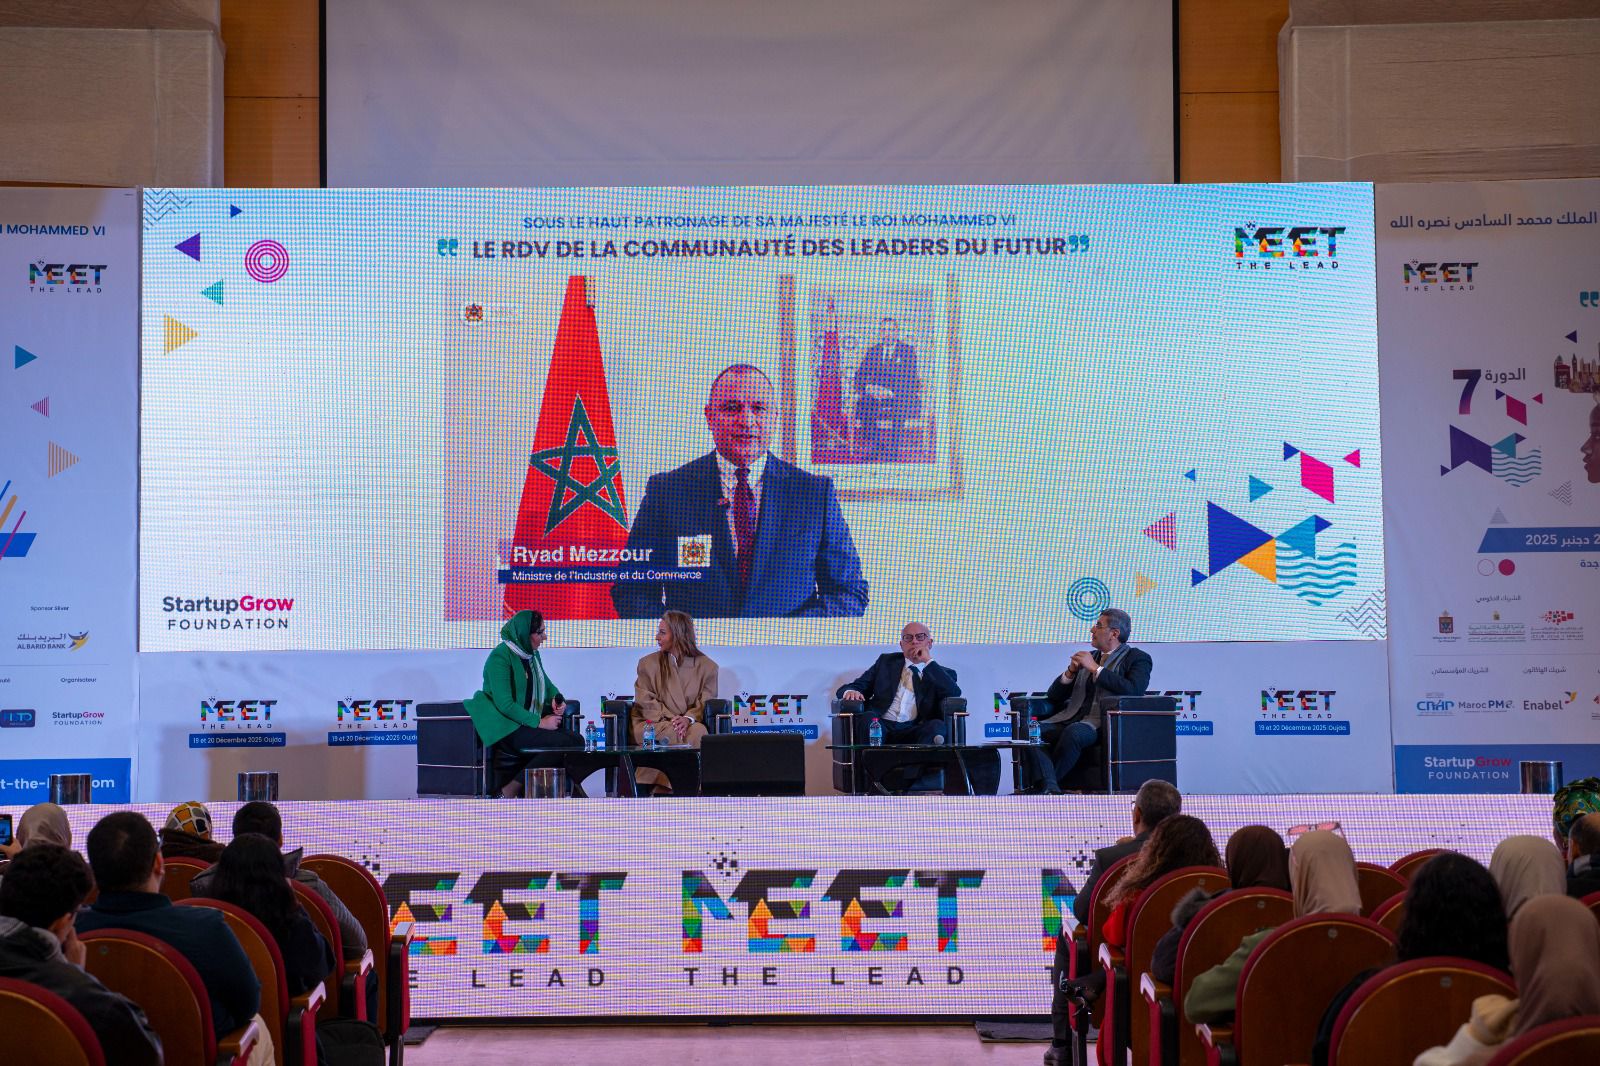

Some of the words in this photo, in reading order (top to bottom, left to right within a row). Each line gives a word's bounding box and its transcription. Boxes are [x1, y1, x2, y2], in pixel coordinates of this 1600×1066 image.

[524, 216, 565, 229] SOUS
[569, 216, 584, 228] LE
[589, 216, 628, 228] HAUT
[635, 216, 728, 228] PATRONAGE
[733, 215, 750, 227] DE
[756, 215, 776, 227] SA
[781, 212, 848, 227] MAJESTÉ
[853, 214, 867, 227] LE
[872, 214, 897, 227] ROI
[902, 214, 996, 227] MOHAMMED
[1002, 214, 1015, 226] VI
[1390, 216, 1413, 228] الله
[1417, 216, 1450, 230] نصره
[1455, 214, 1511, 231] السادس
[1516, 215, 1553, 227] محمد
[1556, 211, 1597, 226] الملك
[7, 224, 88, 236] MOHAMMED
[93, 225, 105, 236] VI
[473, 241, 496, 258] LE
[502, 240, 550, 258] RDV
[557, 240, 590, 258] DE
[592, 240, 617, 257] LA
[624, 234, 795, 257] COMMUNAUTÉ
[802, 239, 847, 256] DES
[851, 238, 948, 256] LEADERS
[955, 238, 986, 255] DU
[994, 237, 1066, 255] FUTUR
[1235, 226, 1346, 257] MEET
[1290, 261, 1338, 269] LEAD
[1404, 263, 1478, 283] MEET
[29, 264, 107, 284] MEET
[1485, 368, 1525, 383] الدورة
[1453, 369, 1481, 415] 7
[1526, 534, 1558, 545] 2025
[513, 546, 563, 566] Ryad
[569, 546, 653, 562] Mezzour
[513, 571, 552, 581] Ministre
[554, 570, 567, 580] de
[620, 571, 630, 580] et
[632, 570, 645, 580] du
[647, 570, 702, 580] Commerce
[162, 595, 294, 615] StartupGrow
[168, 618, 288, 630] FOUNDATION
[734, 695, 808, 715] MEET
[1262, 691, 1336, 710] MEET
[1459, 701, 1487, 709] Maroc
[1524, 701, 1563, 710] Enabel
[201, 700, 277, 721] MEET
[337, 700, 413, 720] MEET
[264, 736, 282, 744] Oujda
[1425, 757, 1512, 769] StartupGrow
[1428, 771, 1509, 779] FOUNDATION
[682, 869, 986, 952] MEET
[472, 968, 605, 988] LEAD
[684, 967, 777, 986] THE
[831, 966, 964, 986] LEAD
